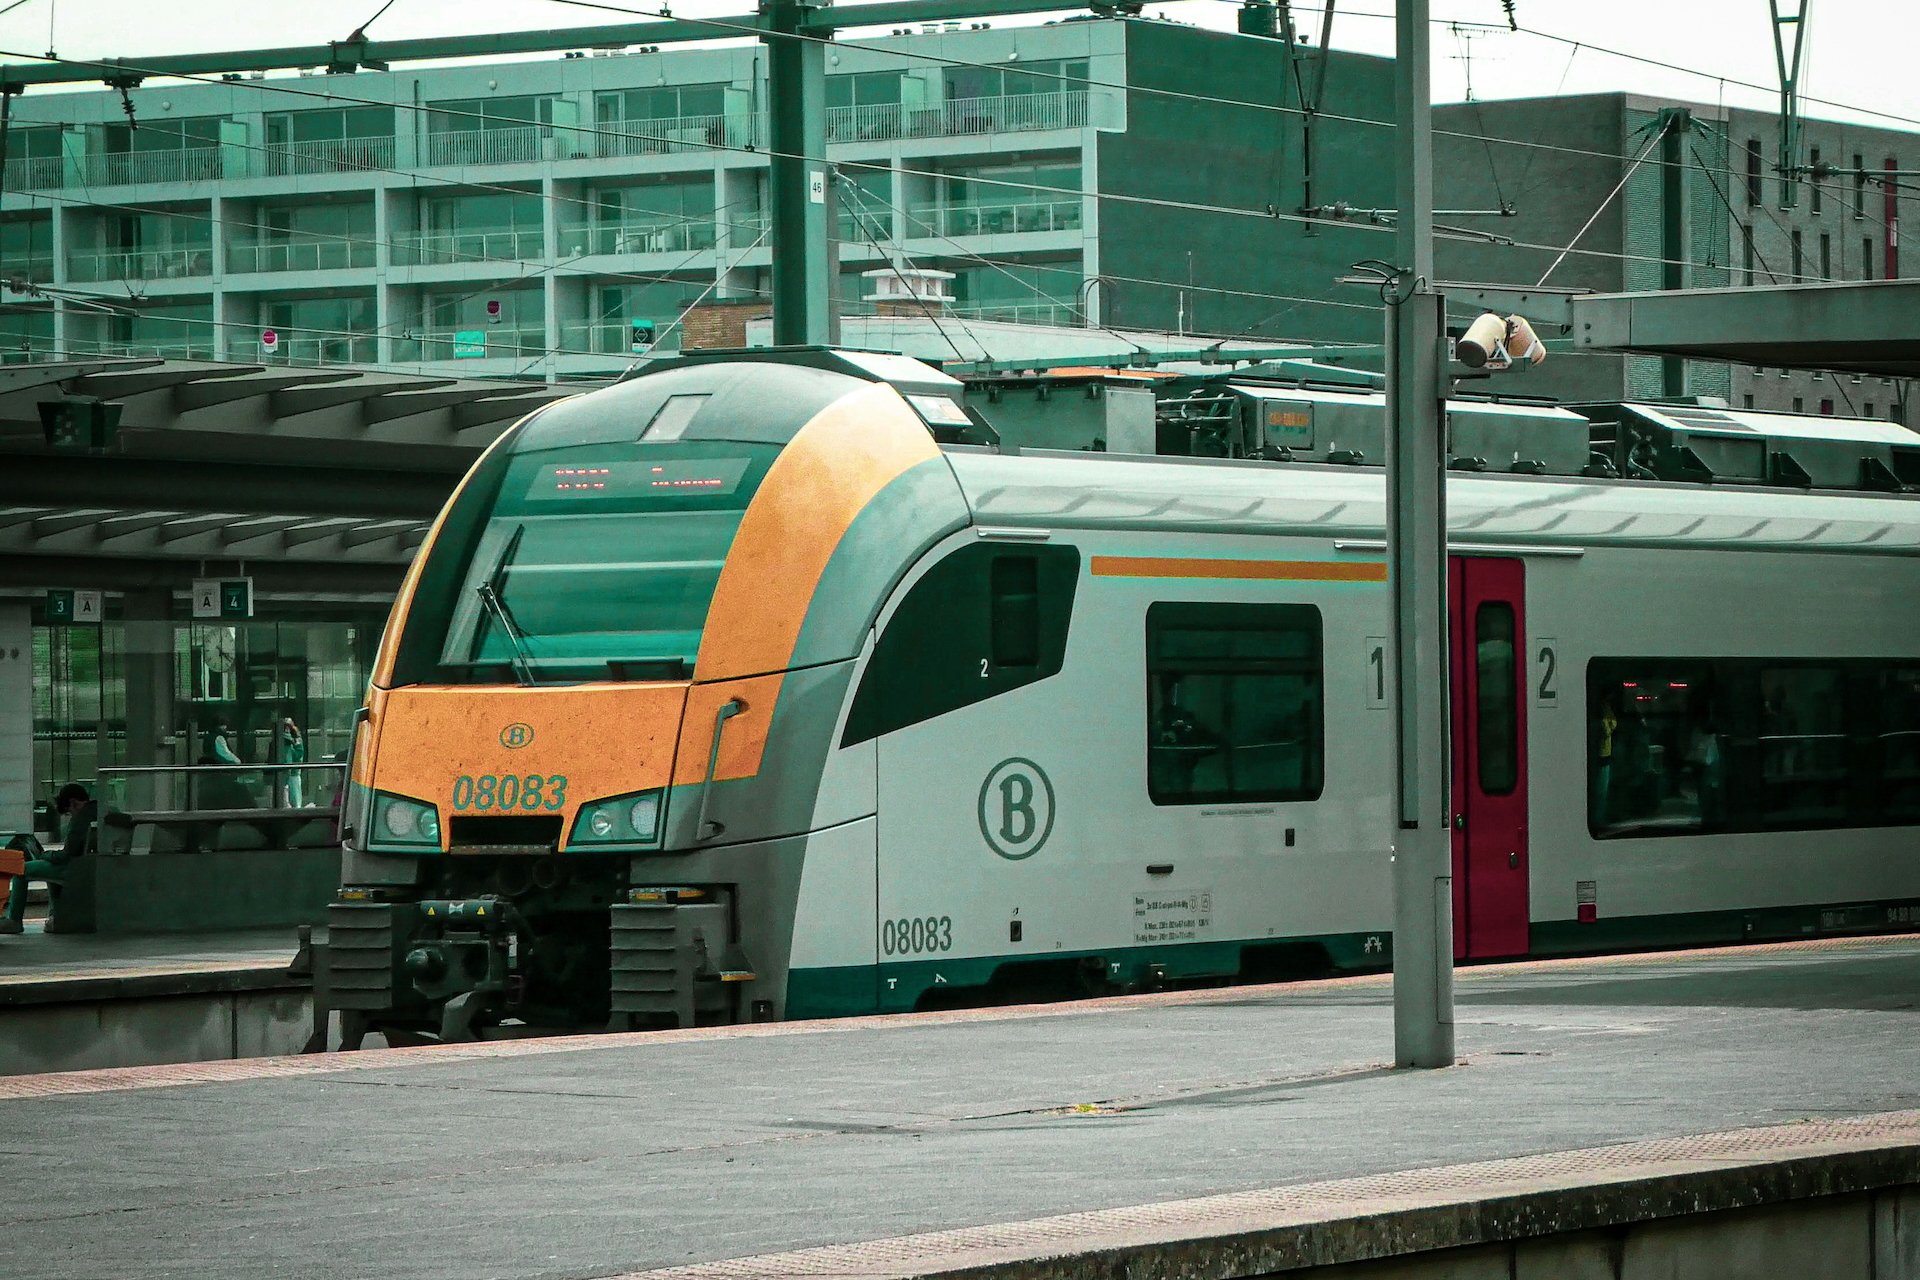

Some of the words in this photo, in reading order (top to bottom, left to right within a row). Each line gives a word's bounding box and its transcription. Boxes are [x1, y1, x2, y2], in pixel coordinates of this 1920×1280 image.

[812, 182, 822, 193] 46
[57, 600, 65, 613] 3
[83, 600, 91, 612] A
[203, 596, 211, 607] A
[231, 595, 238, 608] 4
[980, 658, 989, 678] 2
[1371, 646, 1384, 700] 1
[1538, 646, 1556, 699] 2
[452, 774, 569, 811] 08083
[999, 773, 1036, 845] B
[882, 915, 952, 956] 08083
